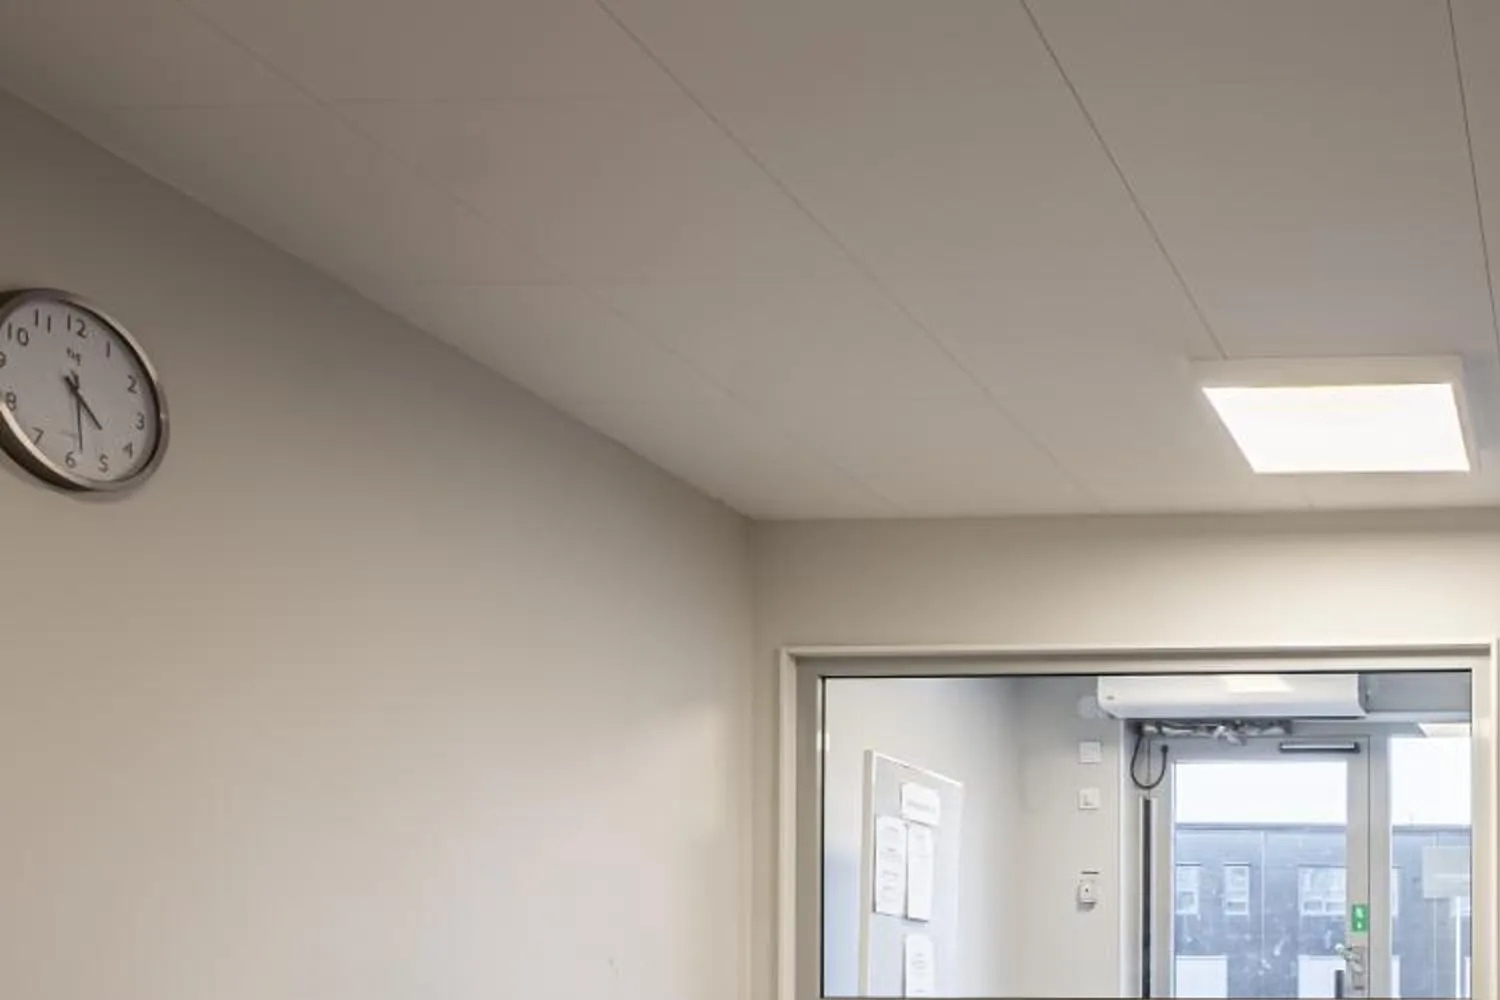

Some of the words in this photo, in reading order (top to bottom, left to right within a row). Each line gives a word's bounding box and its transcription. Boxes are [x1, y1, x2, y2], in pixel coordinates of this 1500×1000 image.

[34, 309, 52, 333] 11
[67, 314, 87, 339] 12
[7, 322, 30, 346] 10
[105, 341, 111, 358] 1
[127, 374, 138, 394] 2
[5, 391, 18, 412] 8
[135, 411, 146, 431] 3
[32, 426, 45, 446] 7
[65, 451, 77, 469] 6
[98, 454, 109, 473] 5
